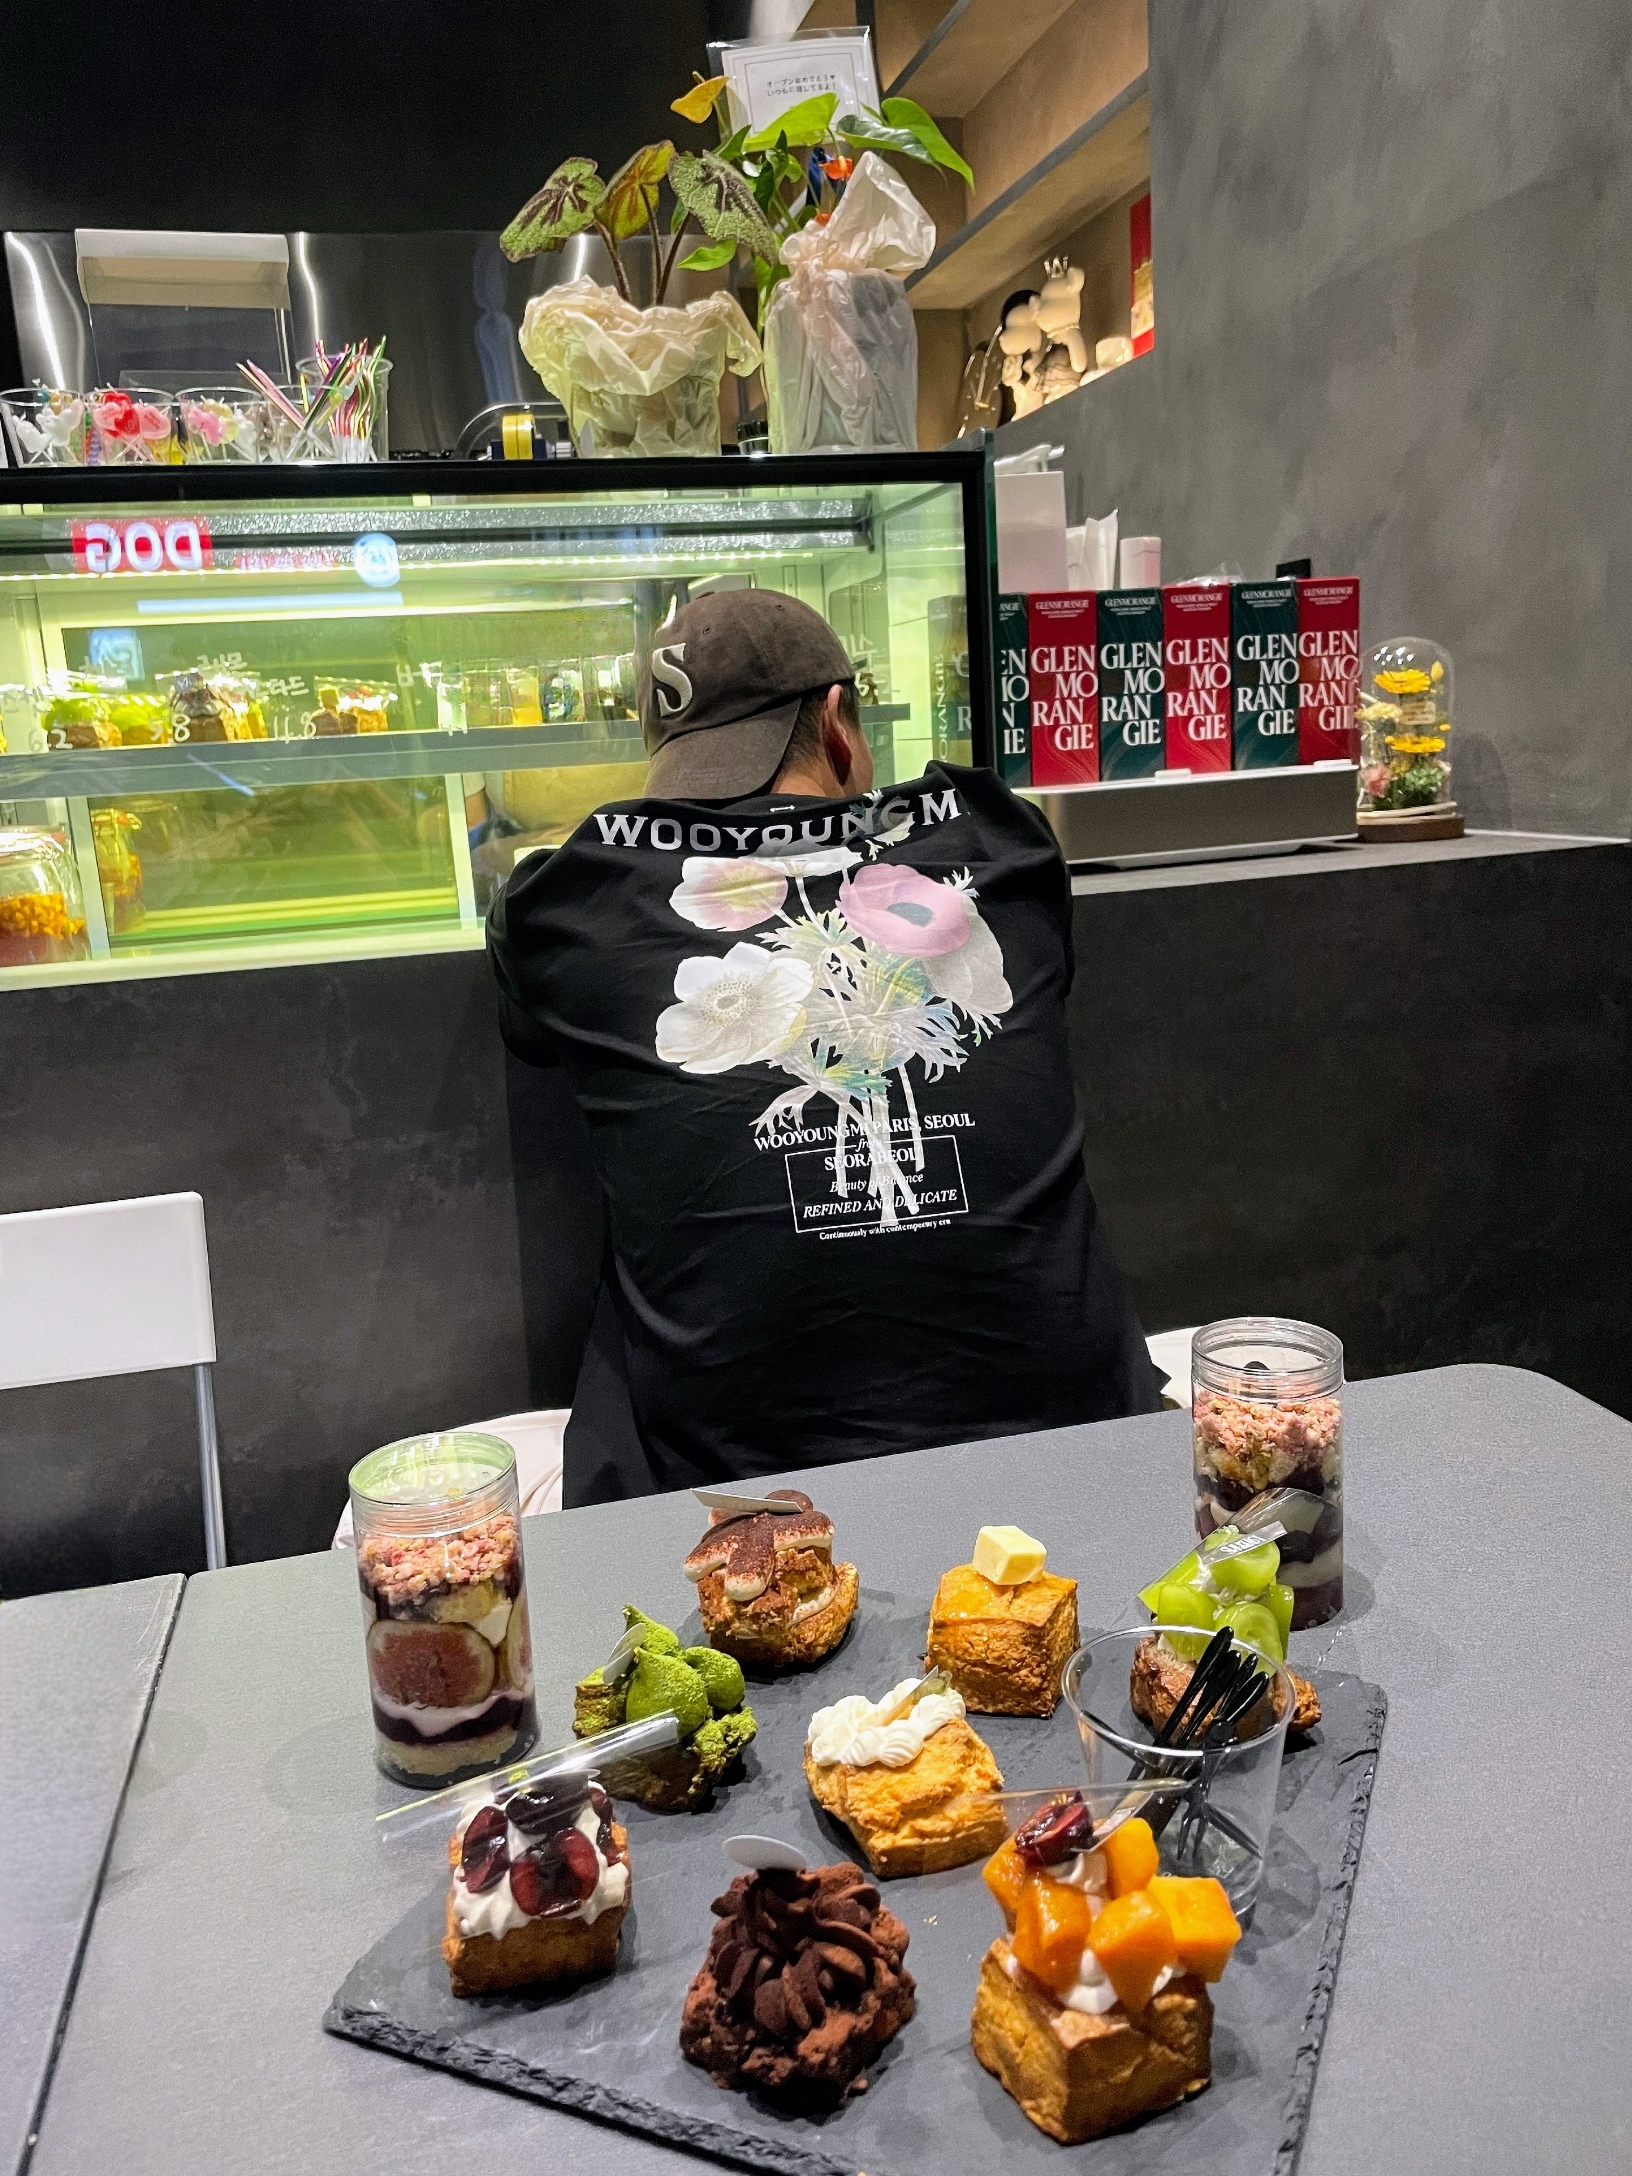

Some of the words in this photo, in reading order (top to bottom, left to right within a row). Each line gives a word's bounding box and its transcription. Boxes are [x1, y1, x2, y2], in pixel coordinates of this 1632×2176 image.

[1100, 642, 1162, 669] GLEN
[1166, 637, 1229, 665] GLEN
[1237, 633, 1297, 660] GLEN
[1299, 630, 1358, 657] GLEN
[1031, 645, 1095, 673] GLEN
[1259, 658, 1299, 684] MO
[652, 643, 693, 718] S
[1055, 671, 1098, 698] MO
[1124, 667, 1165, 695] MO
[1189, 663, 1231, 690] MO
[1101, 694, 1152, 722] RAN
[1167, 690, 1217, 717] RAN
[1237, 685, 1286, 712] RAN
[1033, 699, 1084, 727] RAN
[1258, 709, 1295, 736] GIE
[1054, 724, 1094, 751] GIE
[1123, 719, 1161, 746] GIE
[1188, 714, 1228, 741] GIE
[1003, 728, 1026, 755] IE
[593, 789, 962, 851] WOOYOUNGM
[924, 1113, 975, 1130] SEOUL
[803, 1200, 862, 1218] REFINED
